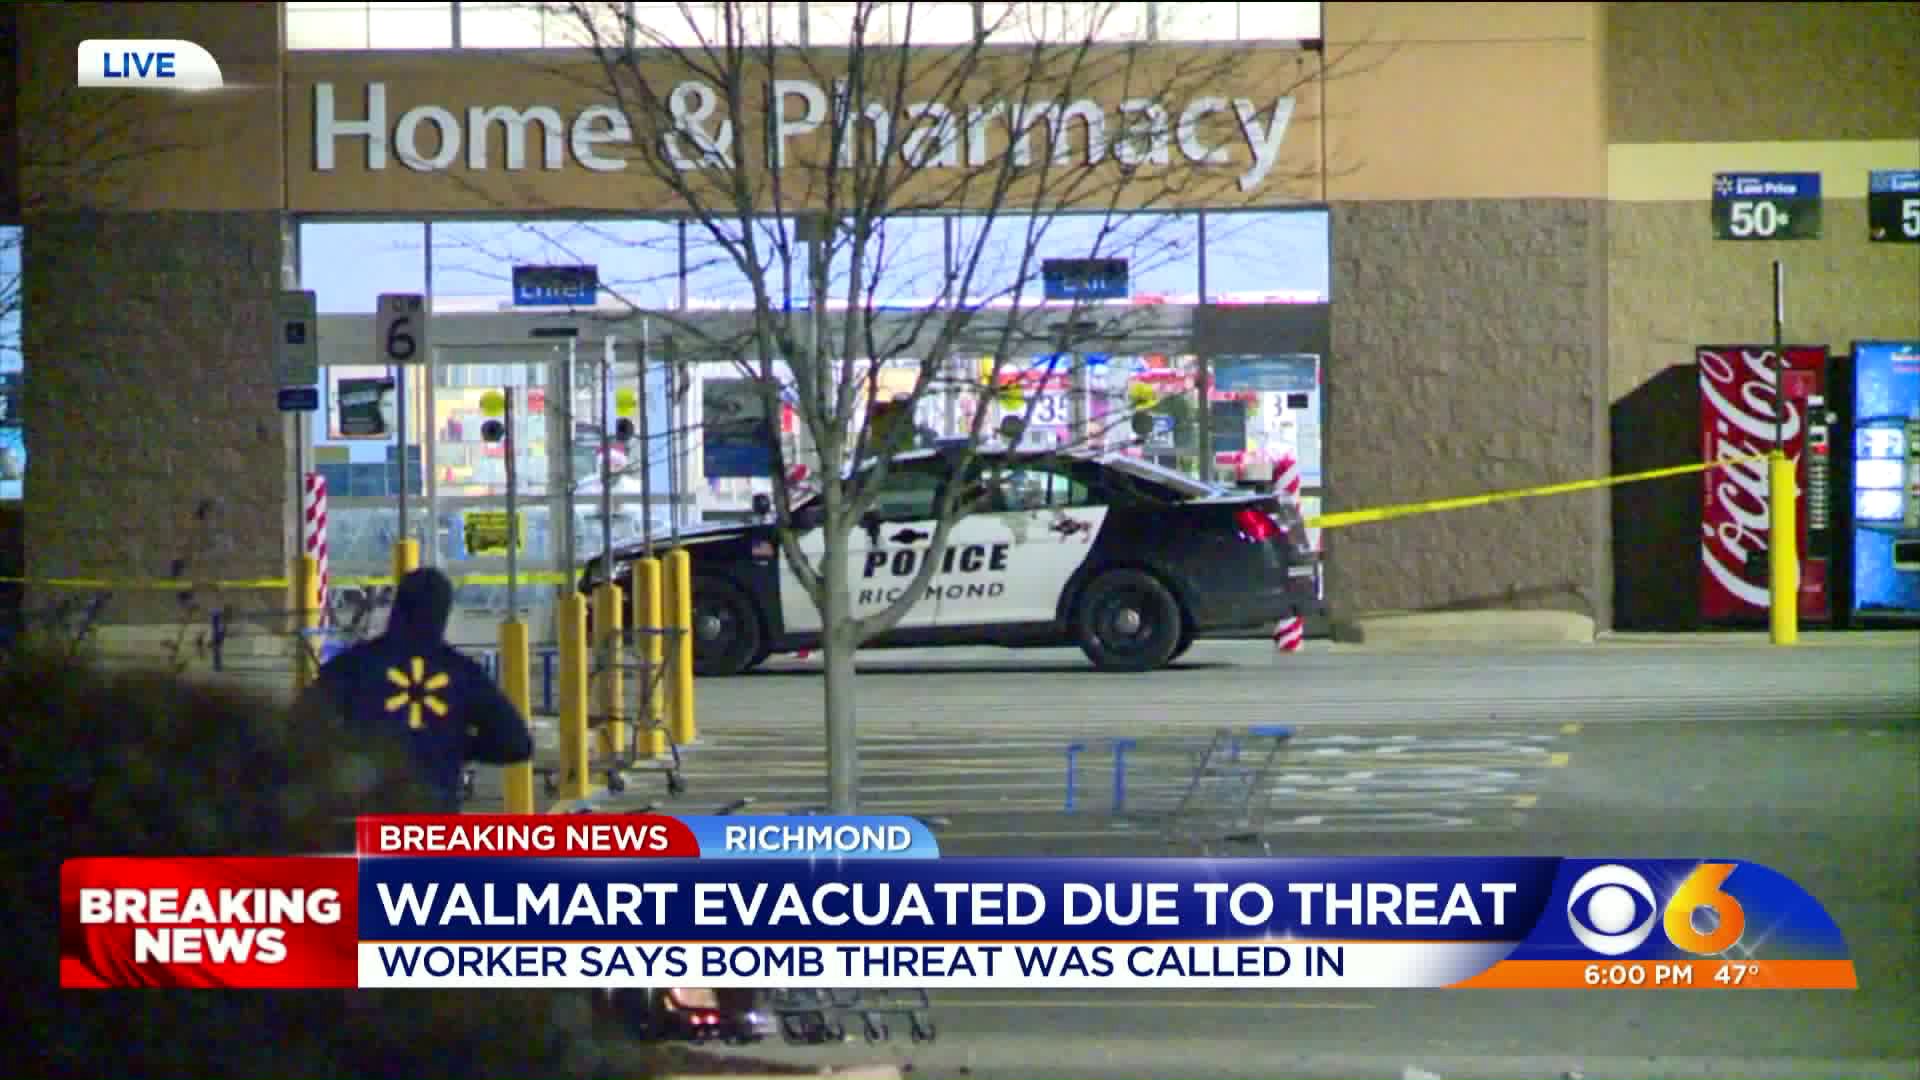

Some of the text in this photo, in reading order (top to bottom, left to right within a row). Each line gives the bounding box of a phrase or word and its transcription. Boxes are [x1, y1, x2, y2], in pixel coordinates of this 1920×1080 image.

[312, 79, 1296, 191] Home & Pharmacy
[386, 317, 416, 360] 6
[858, 583, 1005, 606] RICMOND
